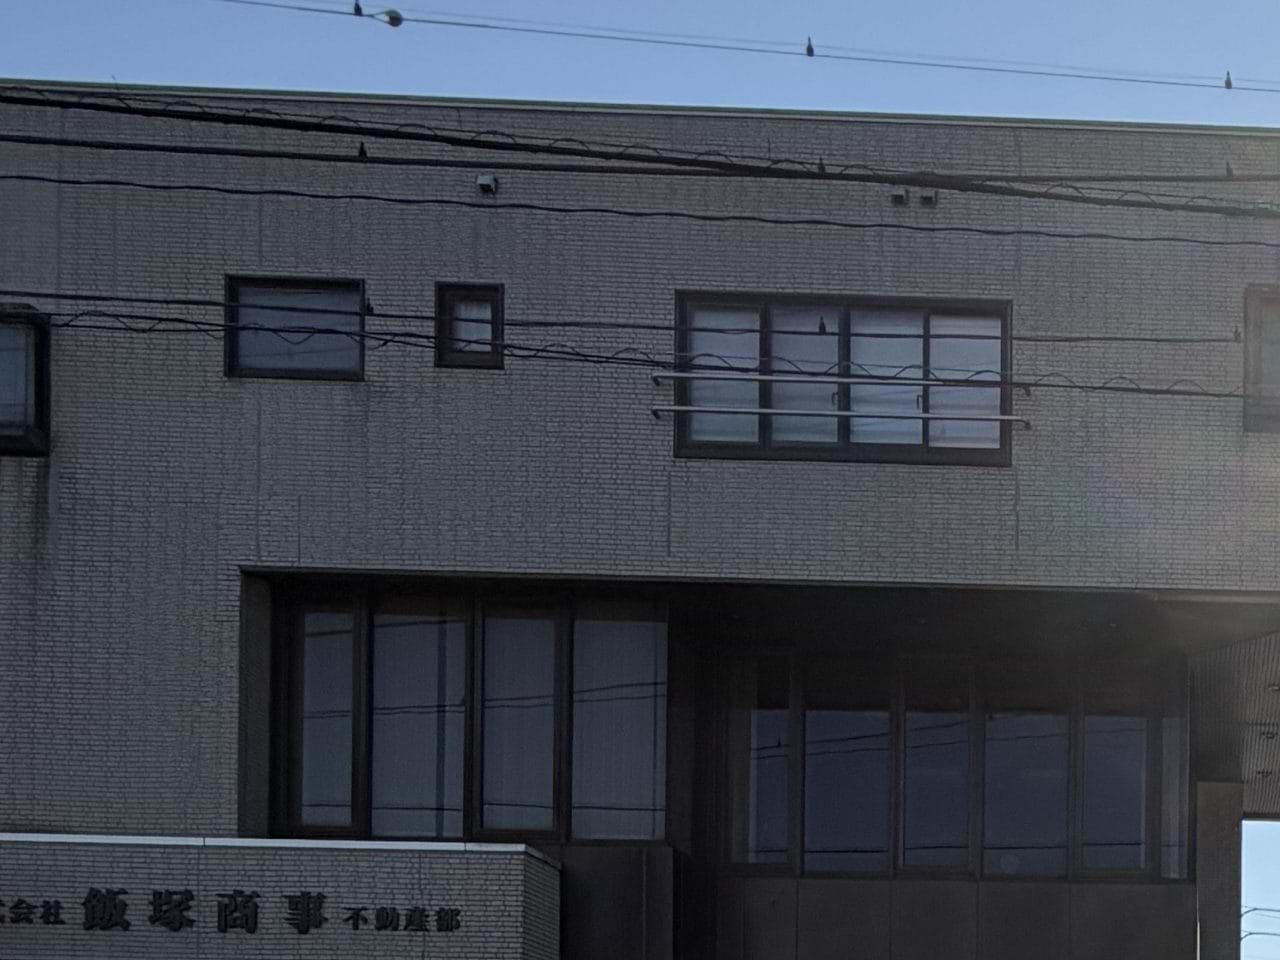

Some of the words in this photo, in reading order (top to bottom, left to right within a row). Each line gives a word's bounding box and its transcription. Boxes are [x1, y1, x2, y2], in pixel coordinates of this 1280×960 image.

[0, 898, 66, 925] 会社
[343, 905, 461, 933] 不動産部
